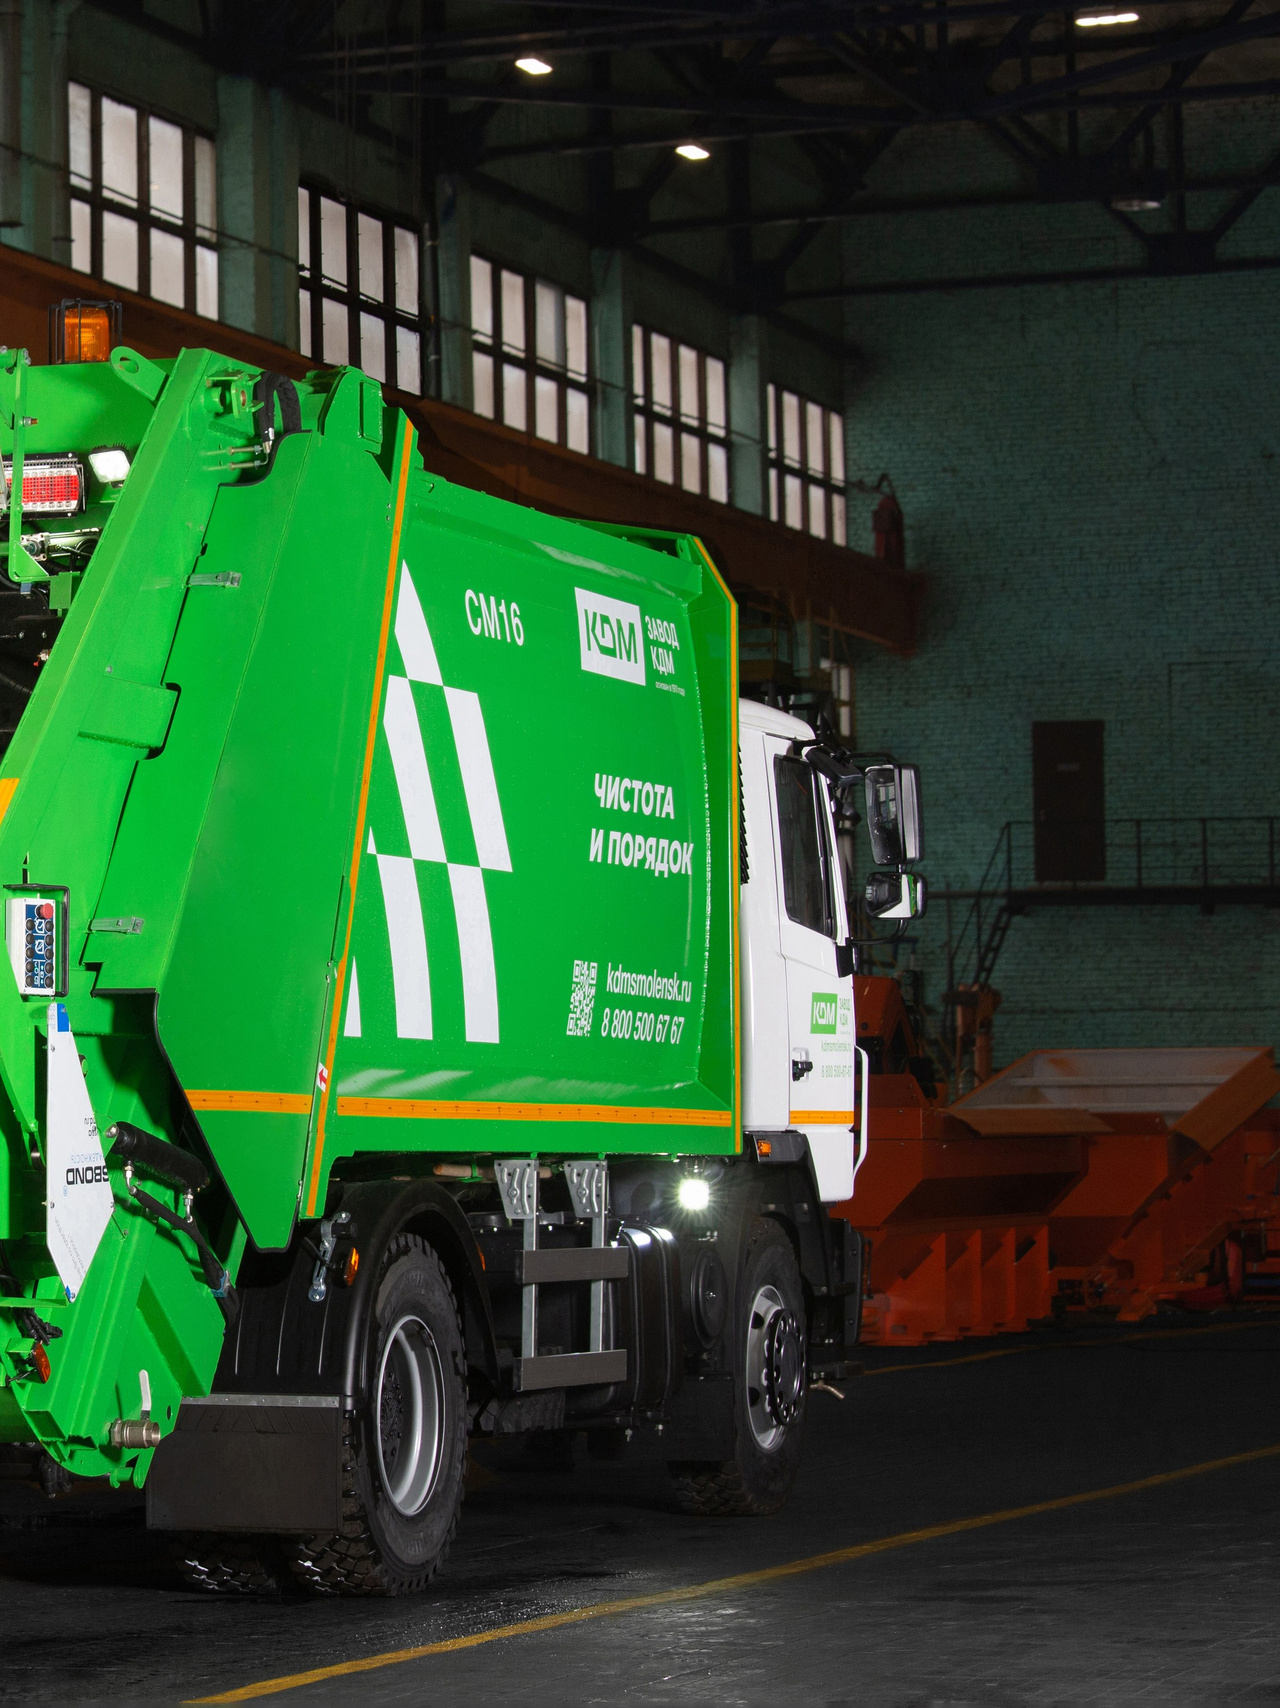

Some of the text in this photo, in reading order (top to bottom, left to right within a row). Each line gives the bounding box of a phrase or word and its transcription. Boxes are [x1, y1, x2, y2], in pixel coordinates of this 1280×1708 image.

[584, 609, 638, 664] KDM
[645, 615, 680, 651] ЗАВОД
[650, 645, 675, 676] КДМ
[594, 773, 675, 820] ЧИСТОТА
[589, 828, 694, 878] И ПОРЯДОК
[606, 962, 692, 1003] kdmsmolensk.ru
[601, 1007, 685, 1045] 8 800 500 67 67
[813, 1002, 835, 1025] KDM
